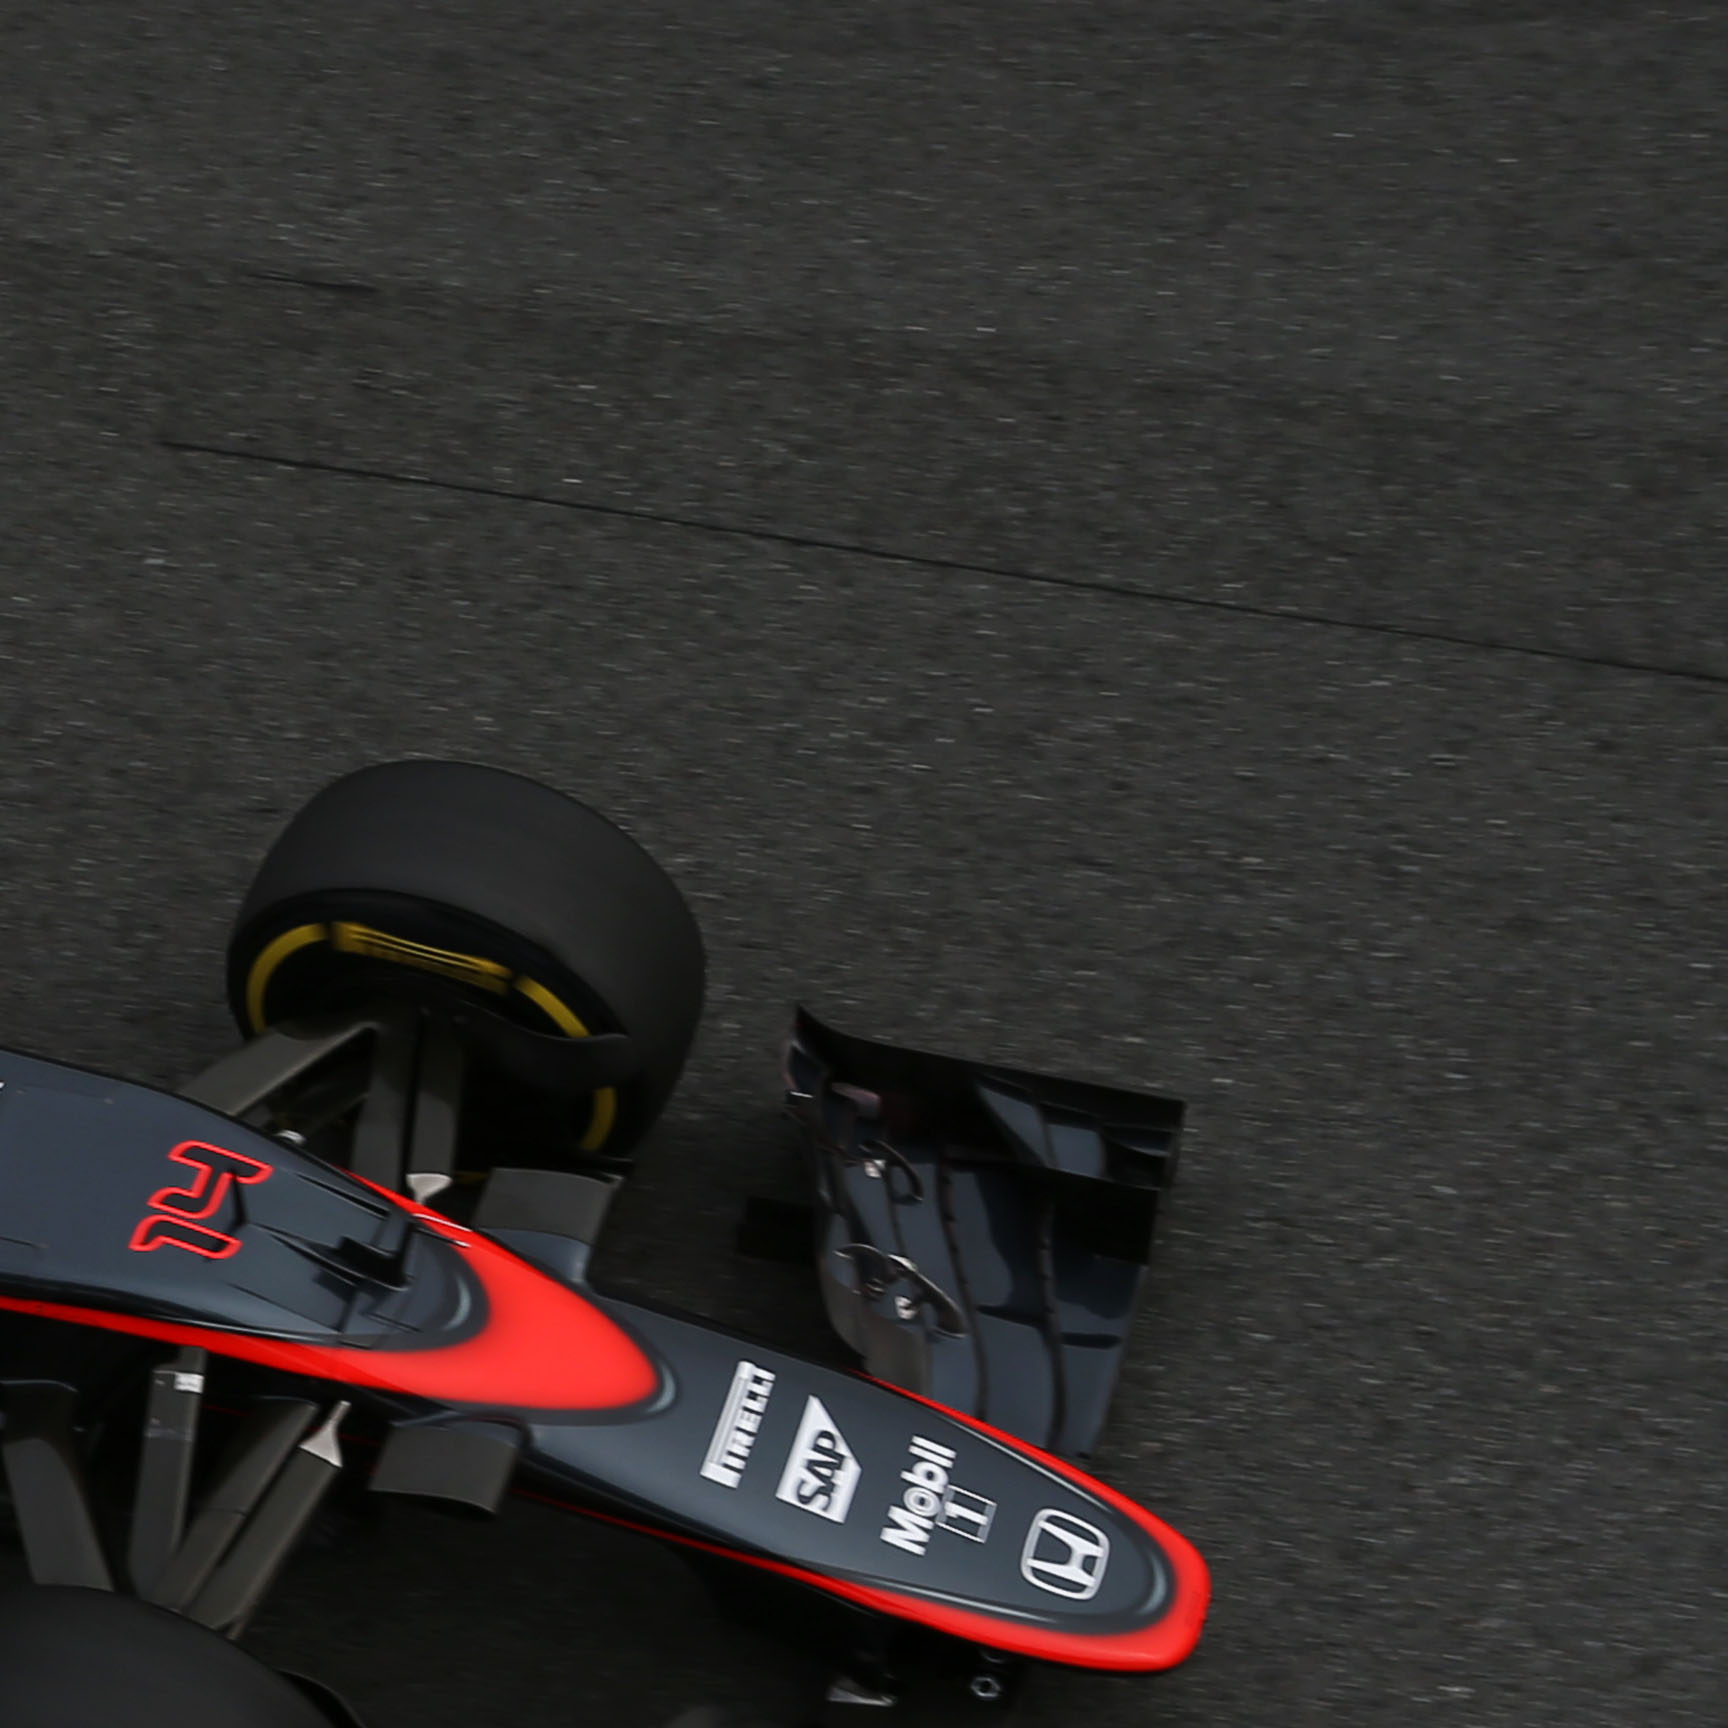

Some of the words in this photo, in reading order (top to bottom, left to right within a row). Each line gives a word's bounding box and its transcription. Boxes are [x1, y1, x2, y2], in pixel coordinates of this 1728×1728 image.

[127, 1139, 276, 1260] 14
[699, 1360, 776, 1489] PIRELLI
[796, 1430, 845, 1512] SAP
[879, 1434, 958, 1557] Mobil
